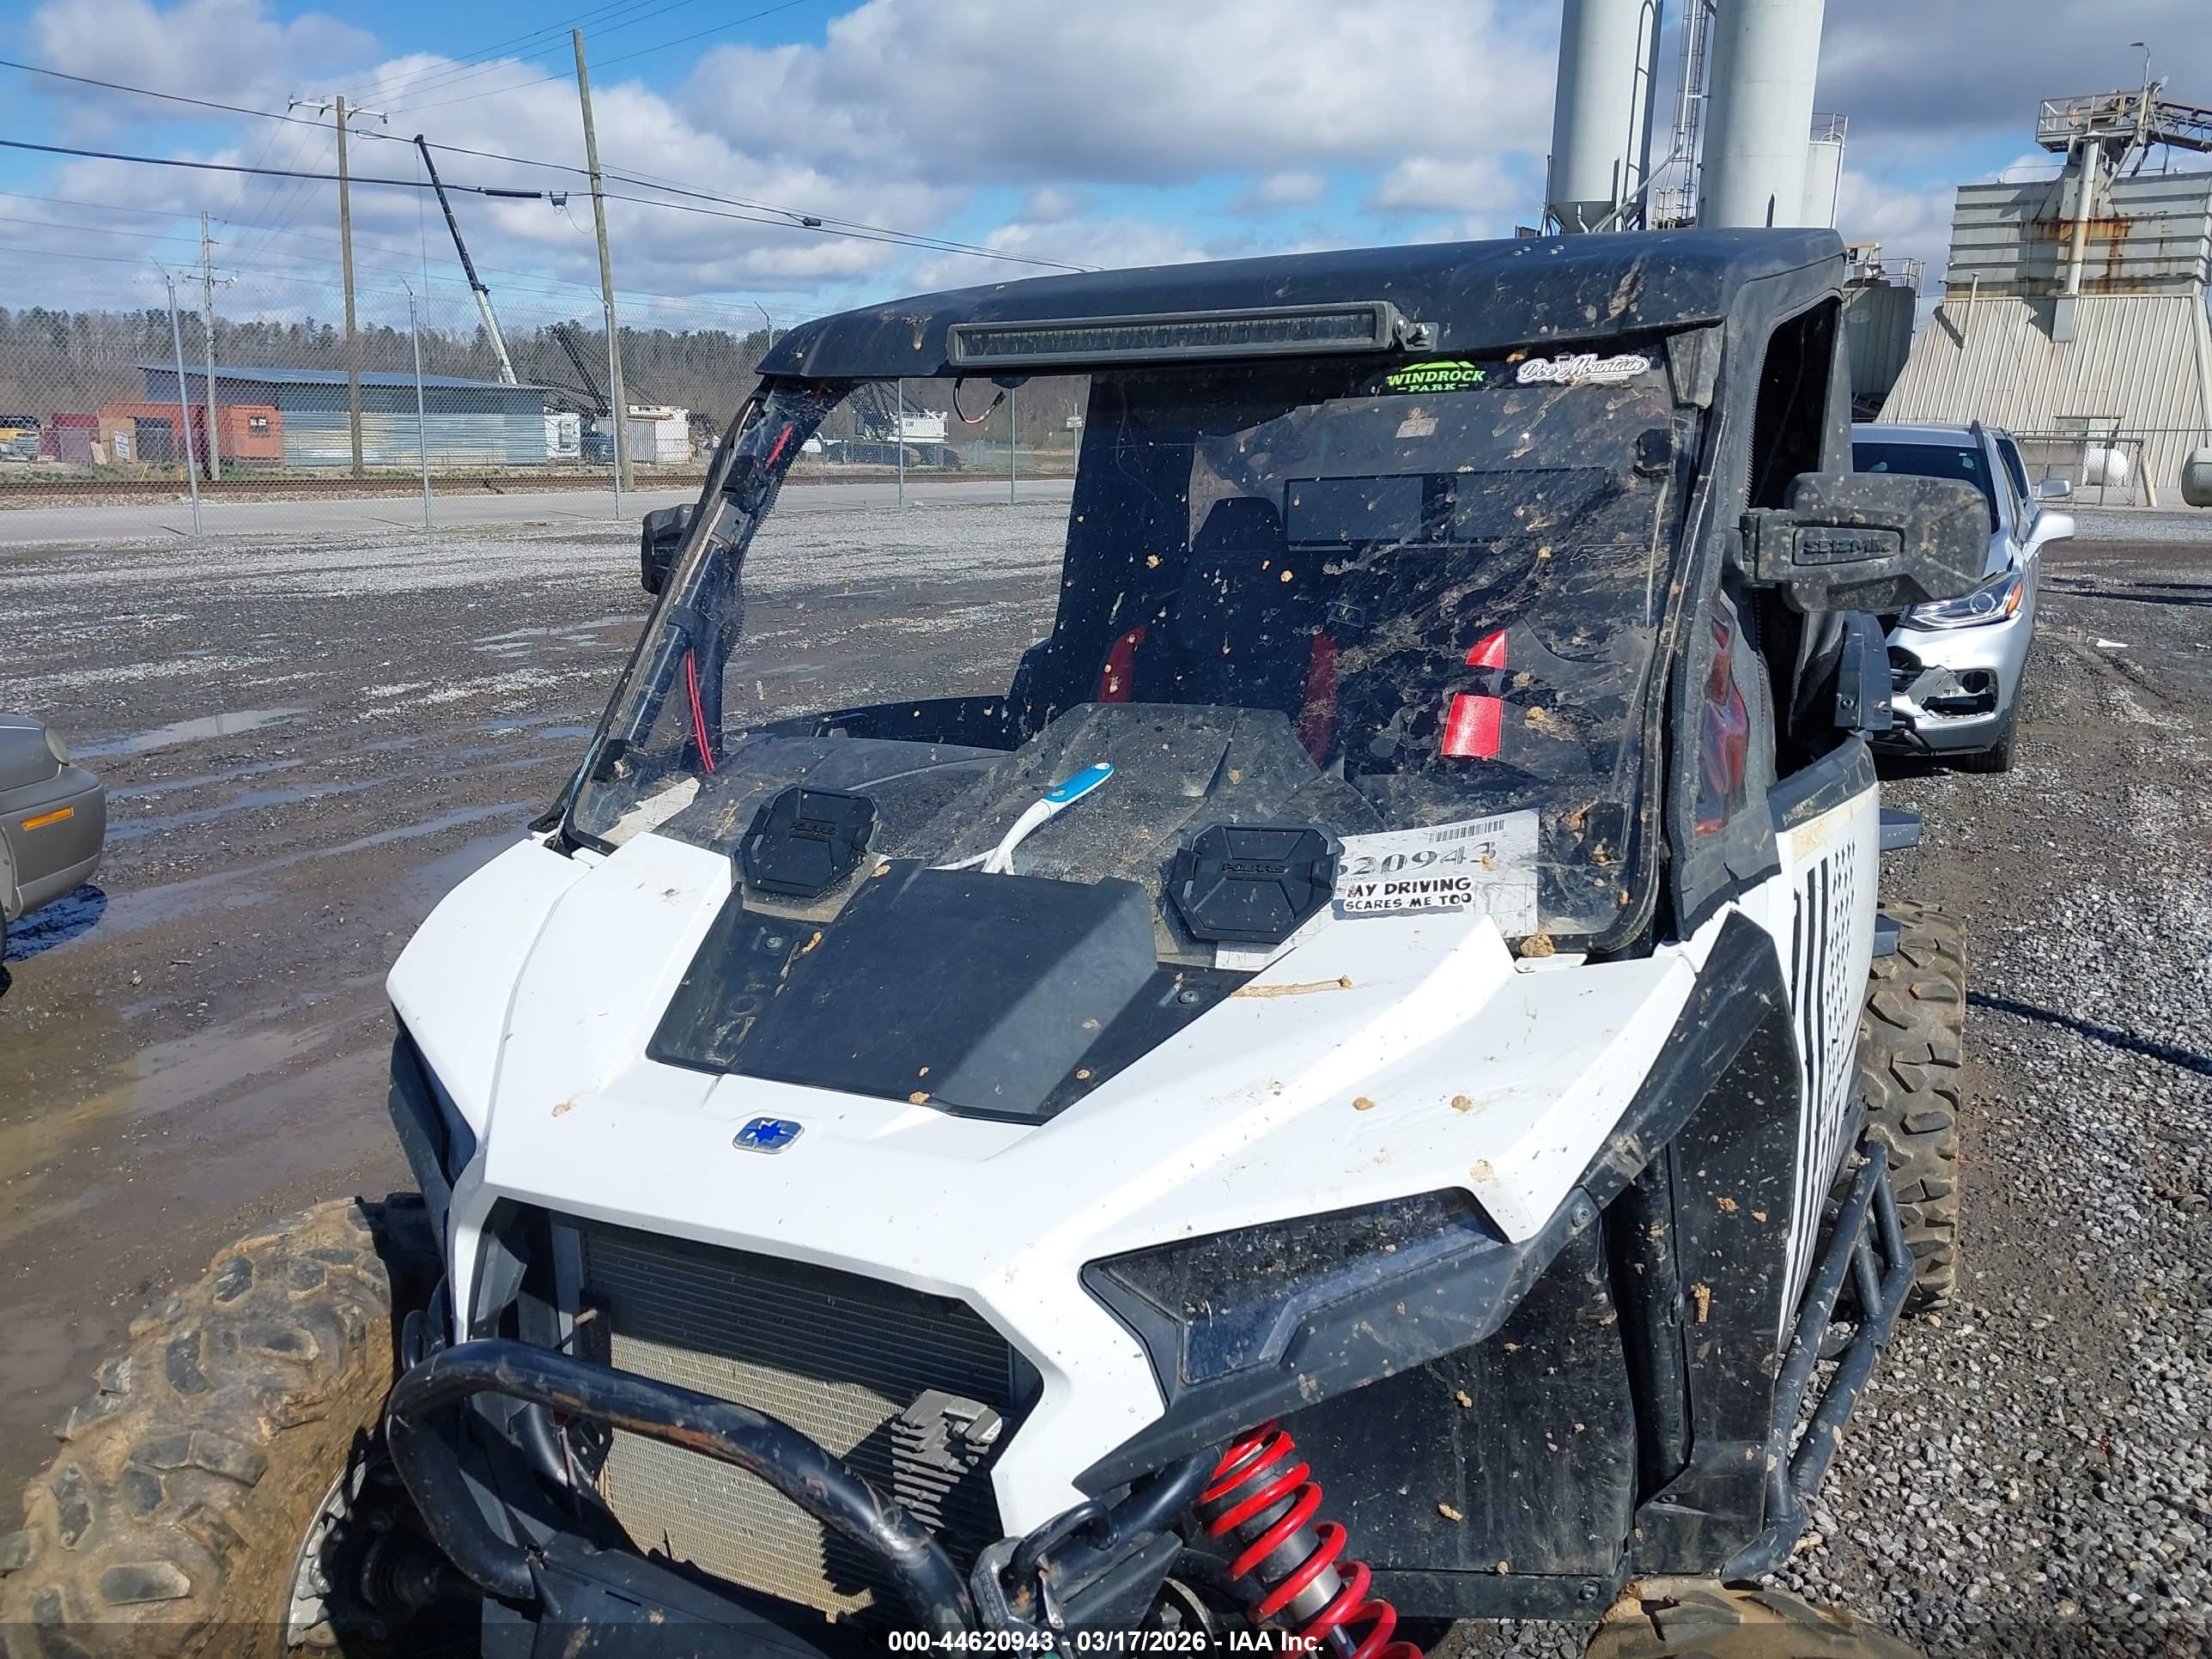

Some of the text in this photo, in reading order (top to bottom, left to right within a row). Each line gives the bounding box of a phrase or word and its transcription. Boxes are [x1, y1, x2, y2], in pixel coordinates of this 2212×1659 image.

[1520, 355, 1644, 380] Doe Mountain
[1386, 370, 1486, 386] WINDROCK
[1407, 383, 1457, 392] PARK
[1569, 543, 1650, 562] RZR
[1802, 538, 1893, 555] SEIZMIK
[1222, 862, 1287, 873] POLARIS
[1346, 877, 1472, 898] MY DRIVING
[1345, 892, 1473, 910] SCARES ME TOO
